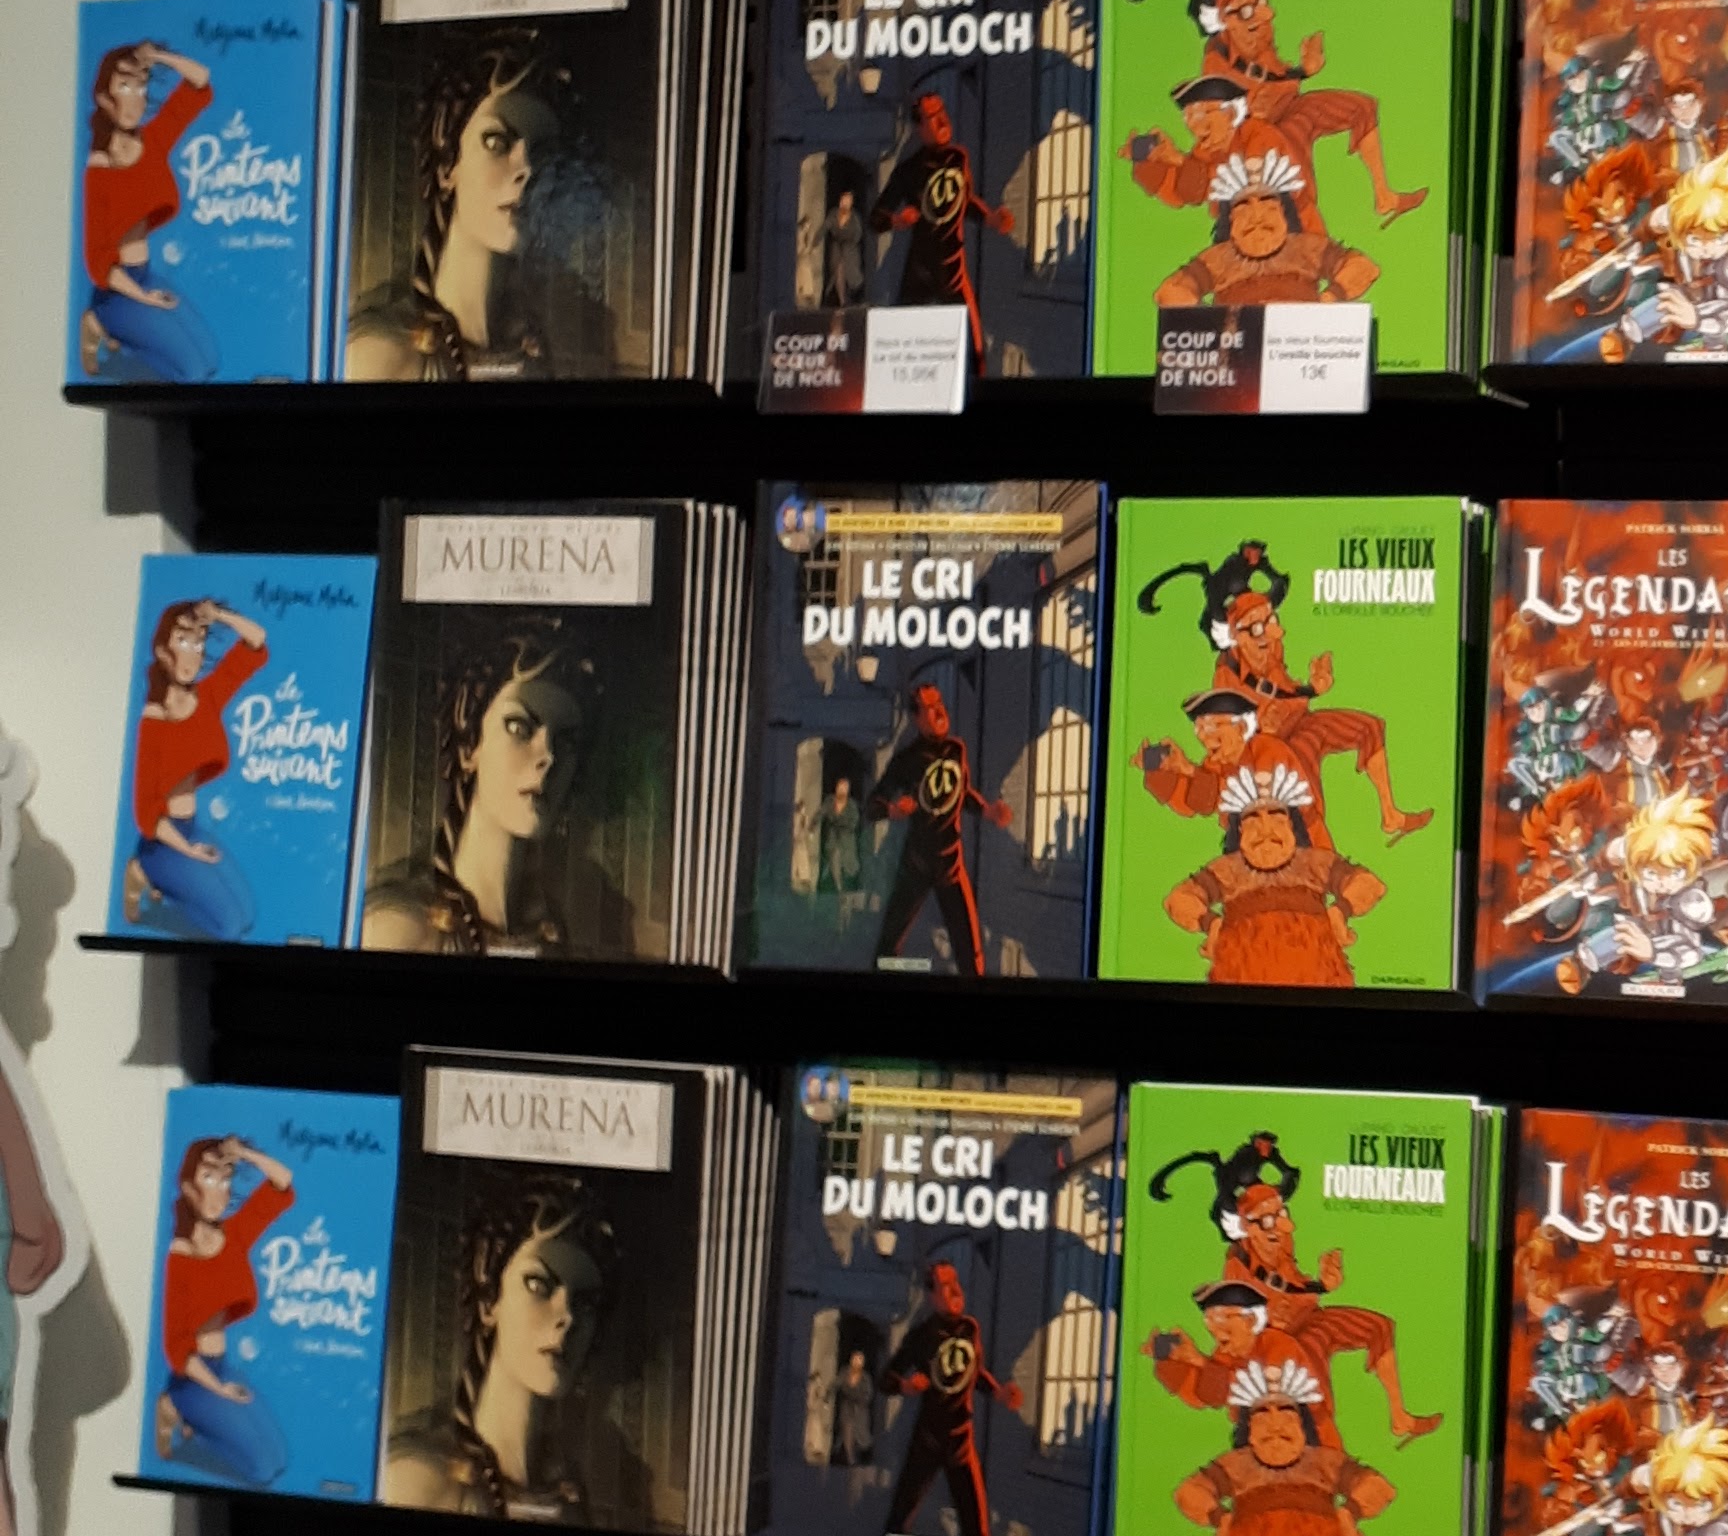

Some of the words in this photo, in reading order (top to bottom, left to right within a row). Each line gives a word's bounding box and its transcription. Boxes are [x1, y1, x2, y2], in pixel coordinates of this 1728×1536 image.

[806, 19, 858, 61] DU
[863, 10, 1034, 59] MOLOCH
[1162, 332, 1216, 349] COUP
[1220, 331, 1244, 348] DE
[1161, 351, 1219, 368] CŒUR
[1161, 369, 1184, 387] DE
[442, 537, 615, 573] MURENA
[1339, 538, 1368, 569] LES
[1376, 538, 1435, 569] VIEUX
[1658, 549, 1687, 567] LES
[862, 559, 903, 599] LE
[911, 558, 975, 600] CRI
[1314, 569, 1436, 603] FOURNEAUX
[803, 605, 856, 646] DU
[862, 605, 1032, 650] MOLOCH
[1590, 624, 1659, 638] WORLD
[462, 1092, 636, 1136] MURENA
[883, 1134, 925, 1172] LE
[931, 1135, 993, 1176] CRI
[1349, 1134, 1380, 1166] LES
[1386, 1135, 1445, 1170] VIEUX
[1322, 1164, 1445, 1203] FOURNEAUX
[1679, 1170, 1711, 1189] LES
[822, 1176, 872, 1218] DU
[881, 1178, 1048, 1230] MOLOCH
